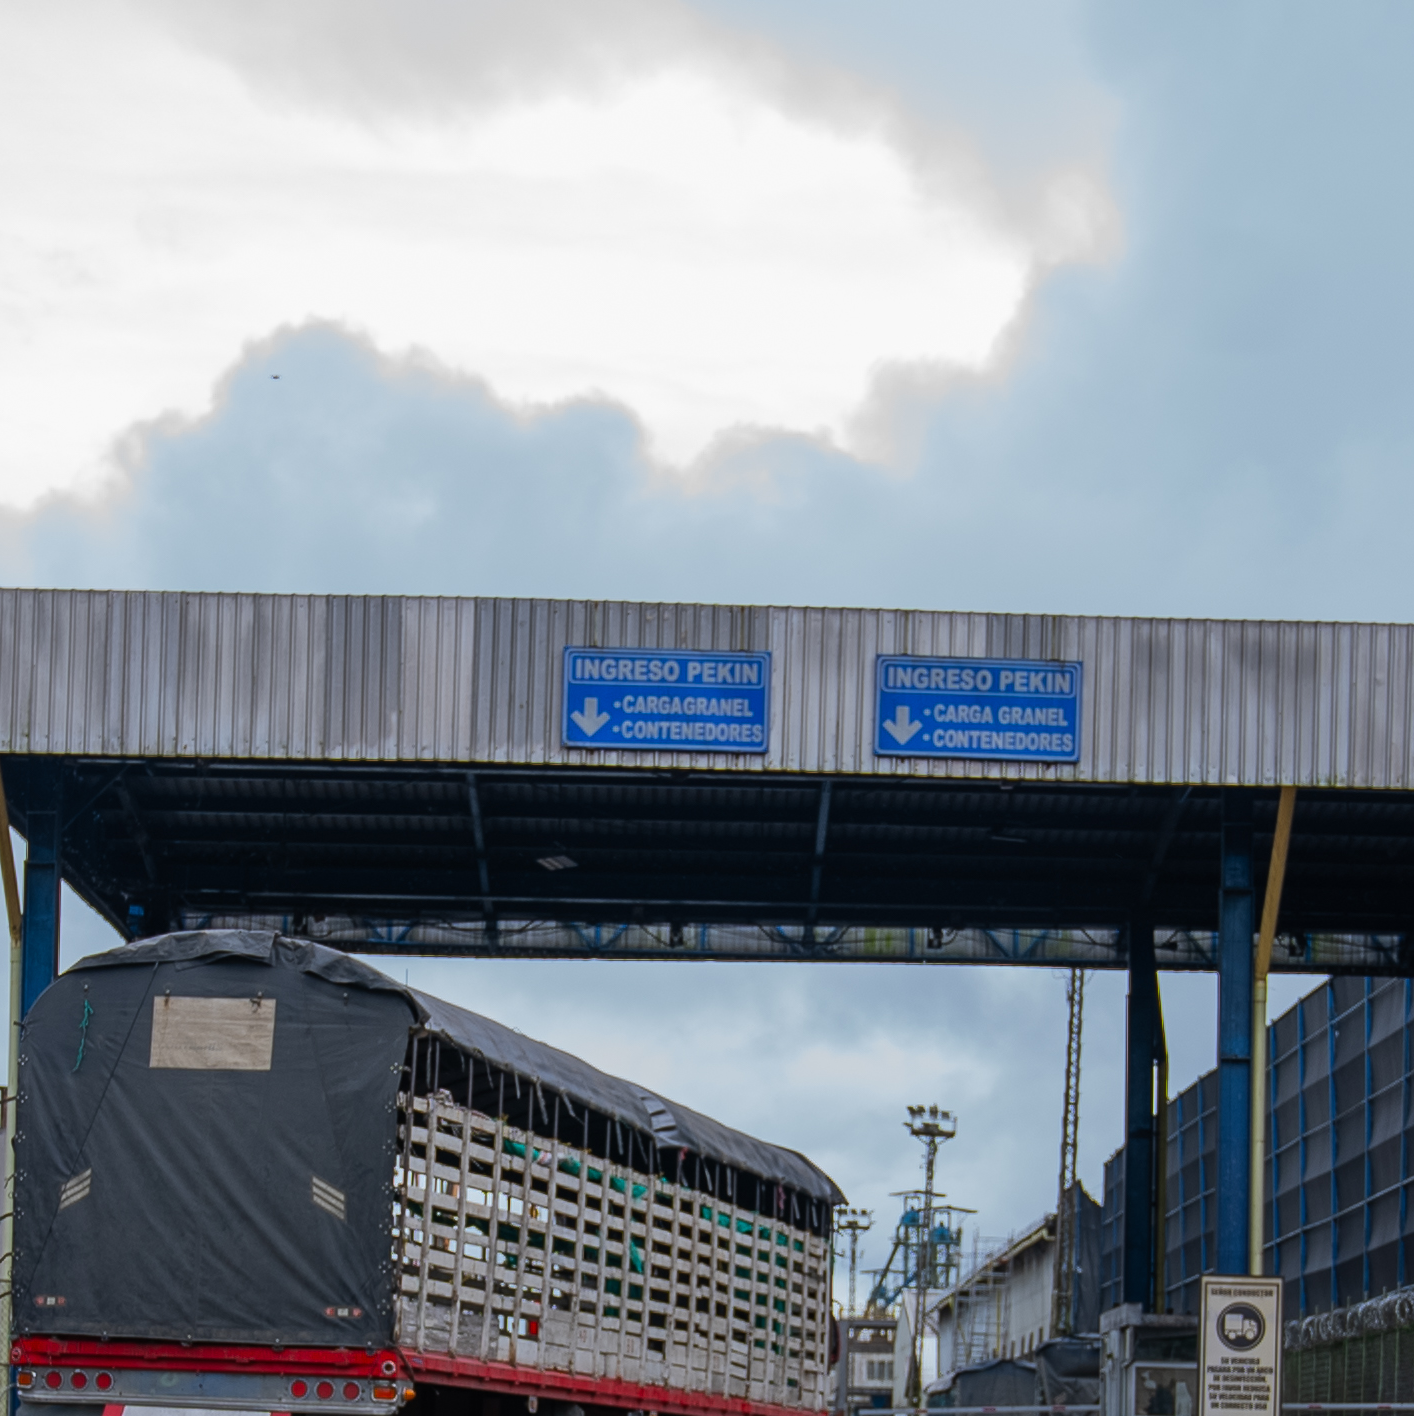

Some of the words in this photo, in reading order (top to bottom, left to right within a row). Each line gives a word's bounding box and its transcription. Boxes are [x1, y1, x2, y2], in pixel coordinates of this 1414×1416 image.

[575, 658, 680, 683] INGRESO
[688, 661, 758, 684] PEKIN
[888, 666, 993, 691] INGRESO
[1000, 669, 1071, 694] PEKIN
[933, 703, 993, 724] CARGA
[998, 706, 1068, 727] GRANEL
[621, 720, 763, 743] CONTENEDORES
[932, 728, 1073, 752] CONTENEDORES
